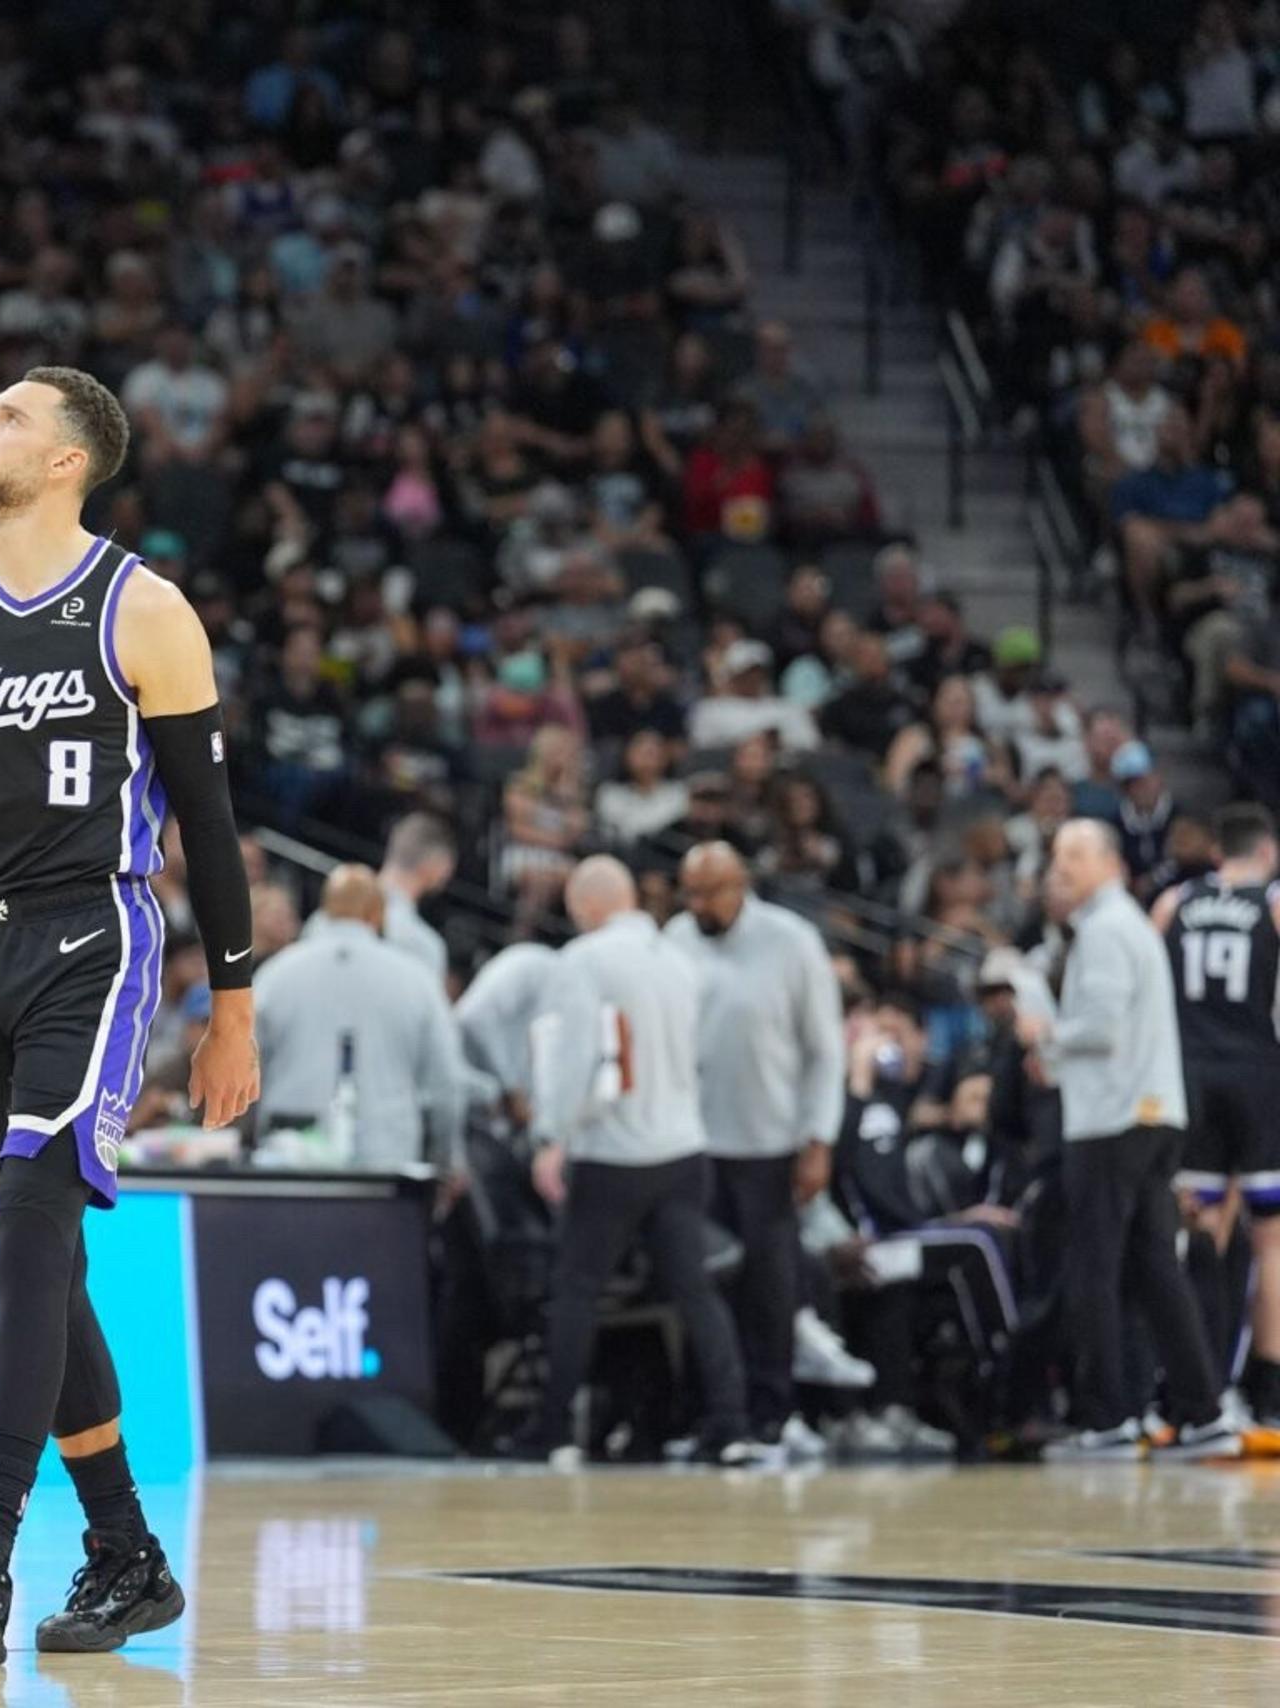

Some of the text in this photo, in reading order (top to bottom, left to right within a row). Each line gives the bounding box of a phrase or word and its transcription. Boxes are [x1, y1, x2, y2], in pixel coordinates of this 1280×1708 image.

[48, 740, 93, 806] 8
[1181, 931, 1252, 1002] 19
[252, 1276, 381, 1380] Self.
